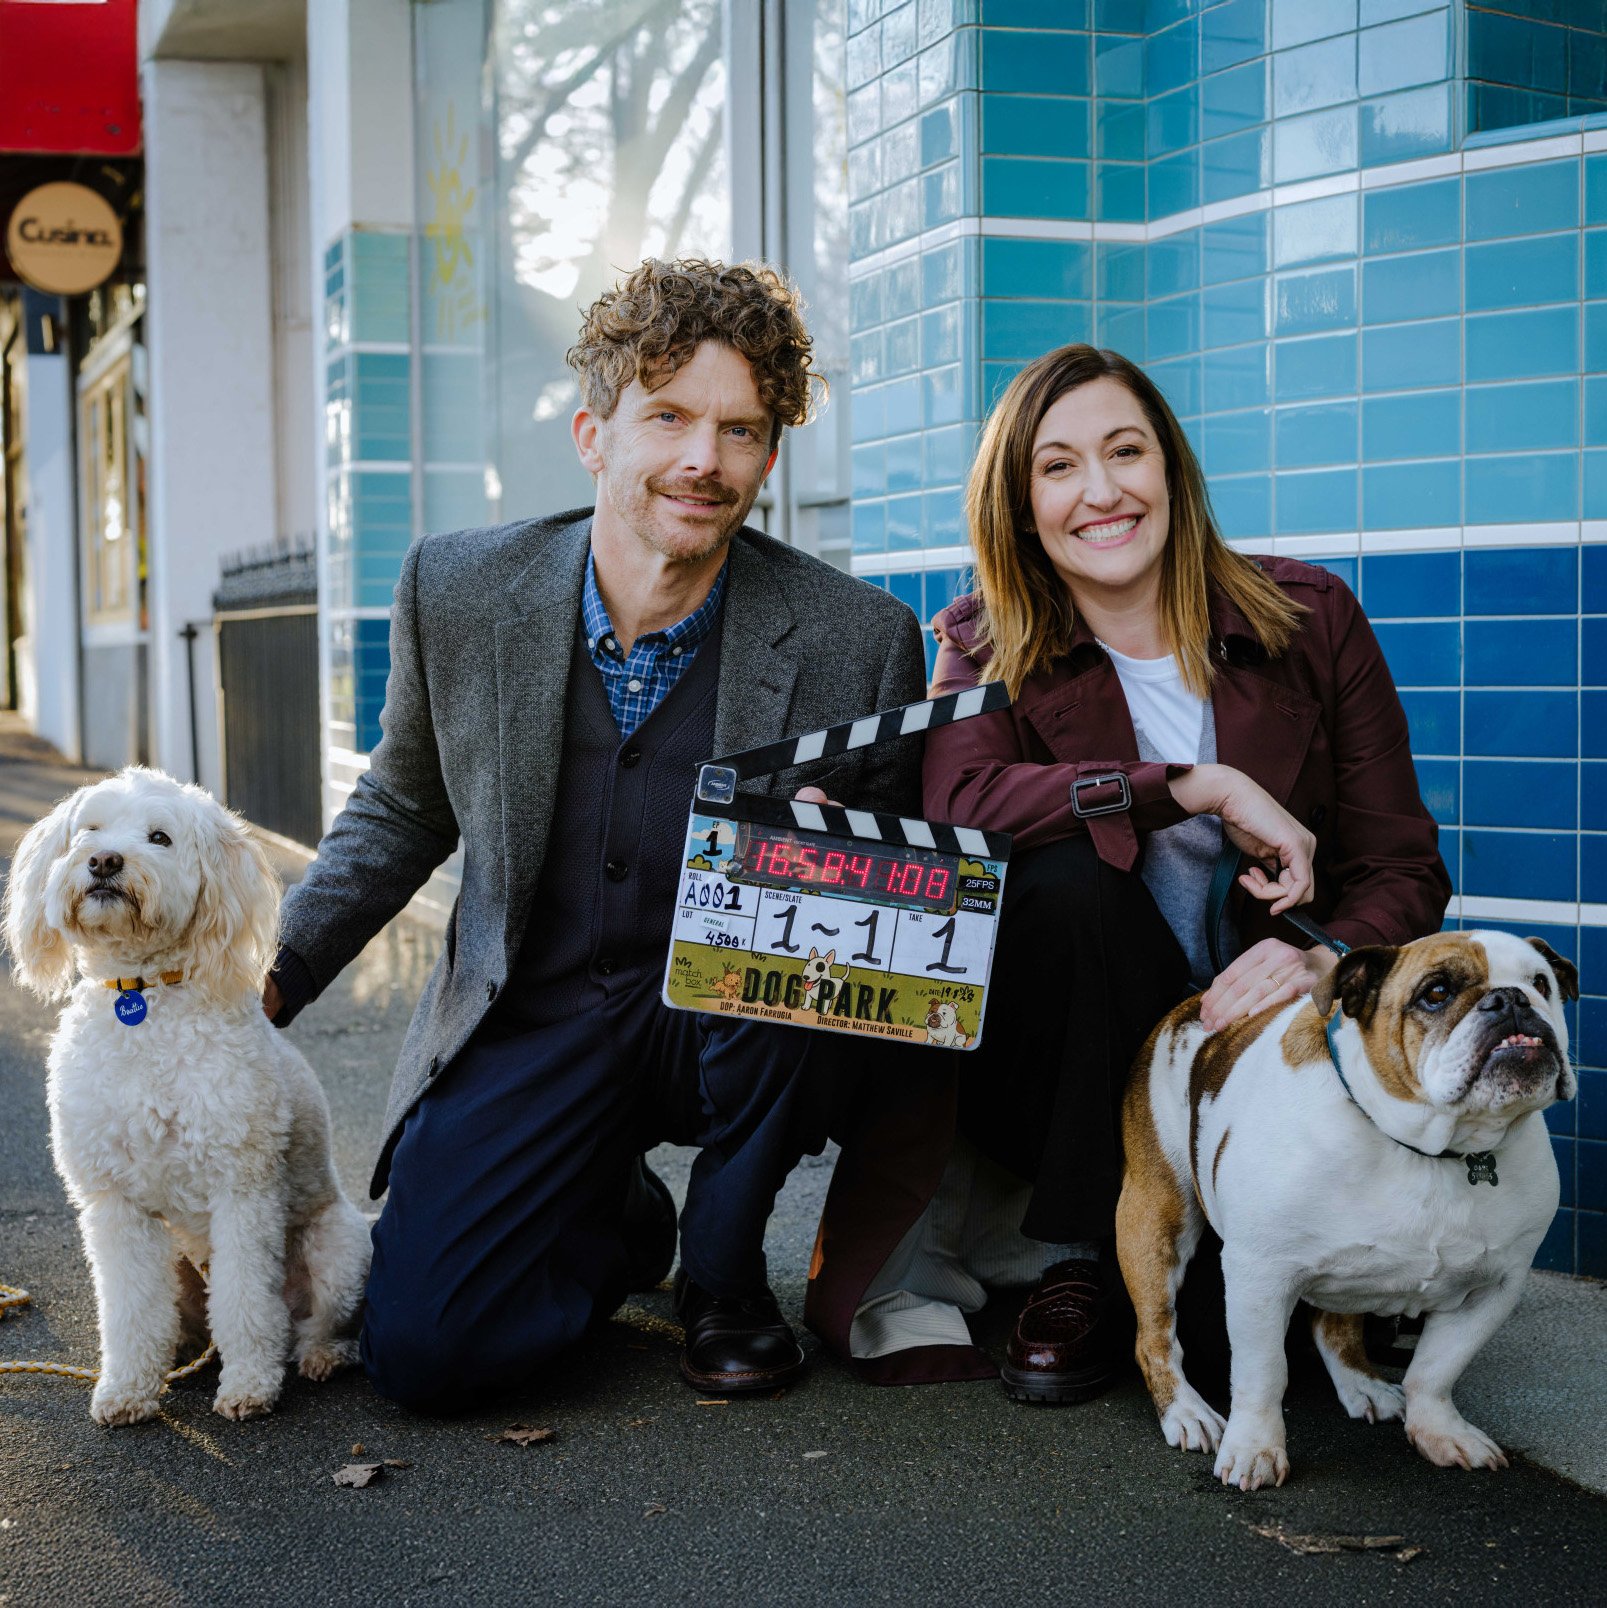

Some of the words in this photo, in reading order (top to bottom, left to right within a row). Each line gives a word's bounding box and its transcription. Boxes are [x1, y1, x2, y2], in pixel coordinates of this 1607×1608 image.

[713, 821, 720, 829] EP
[703, 831, 723, 856] 1
[987, 864, 998, 873] FPS
[689, 872, 703, 881] ROLL
[965, 879, 995, 890] 25FPS
[685, 881, 742, 910] A001
[765, 891, 802, 904] SCENE/SLATE
[962, 897, 992, 910] 32MM
[682, 911, 694, 919] LOT
[909, 913, 923, 923] TAKE
[703, 917, 725, 928] GENERAL
[926, 917, 967, 973] 1
[675, 969, 702, 978] match
[686, 976, 702, 986] box
[741, 967, 801, 1011] DOG
[815, 978, 898, 1024] PARK
[720, 1001, 736, 1012] DOP:
[736, 1004, 759, 1016] AARON
[760, 1007, 792, 1020] FARRUGIA
[816, 1015, 851, 1029] DIRECTOR:
[852, 1021, 885, 1034] MATTHEW
[886, 1026, 913, 1038] SAVILLE
